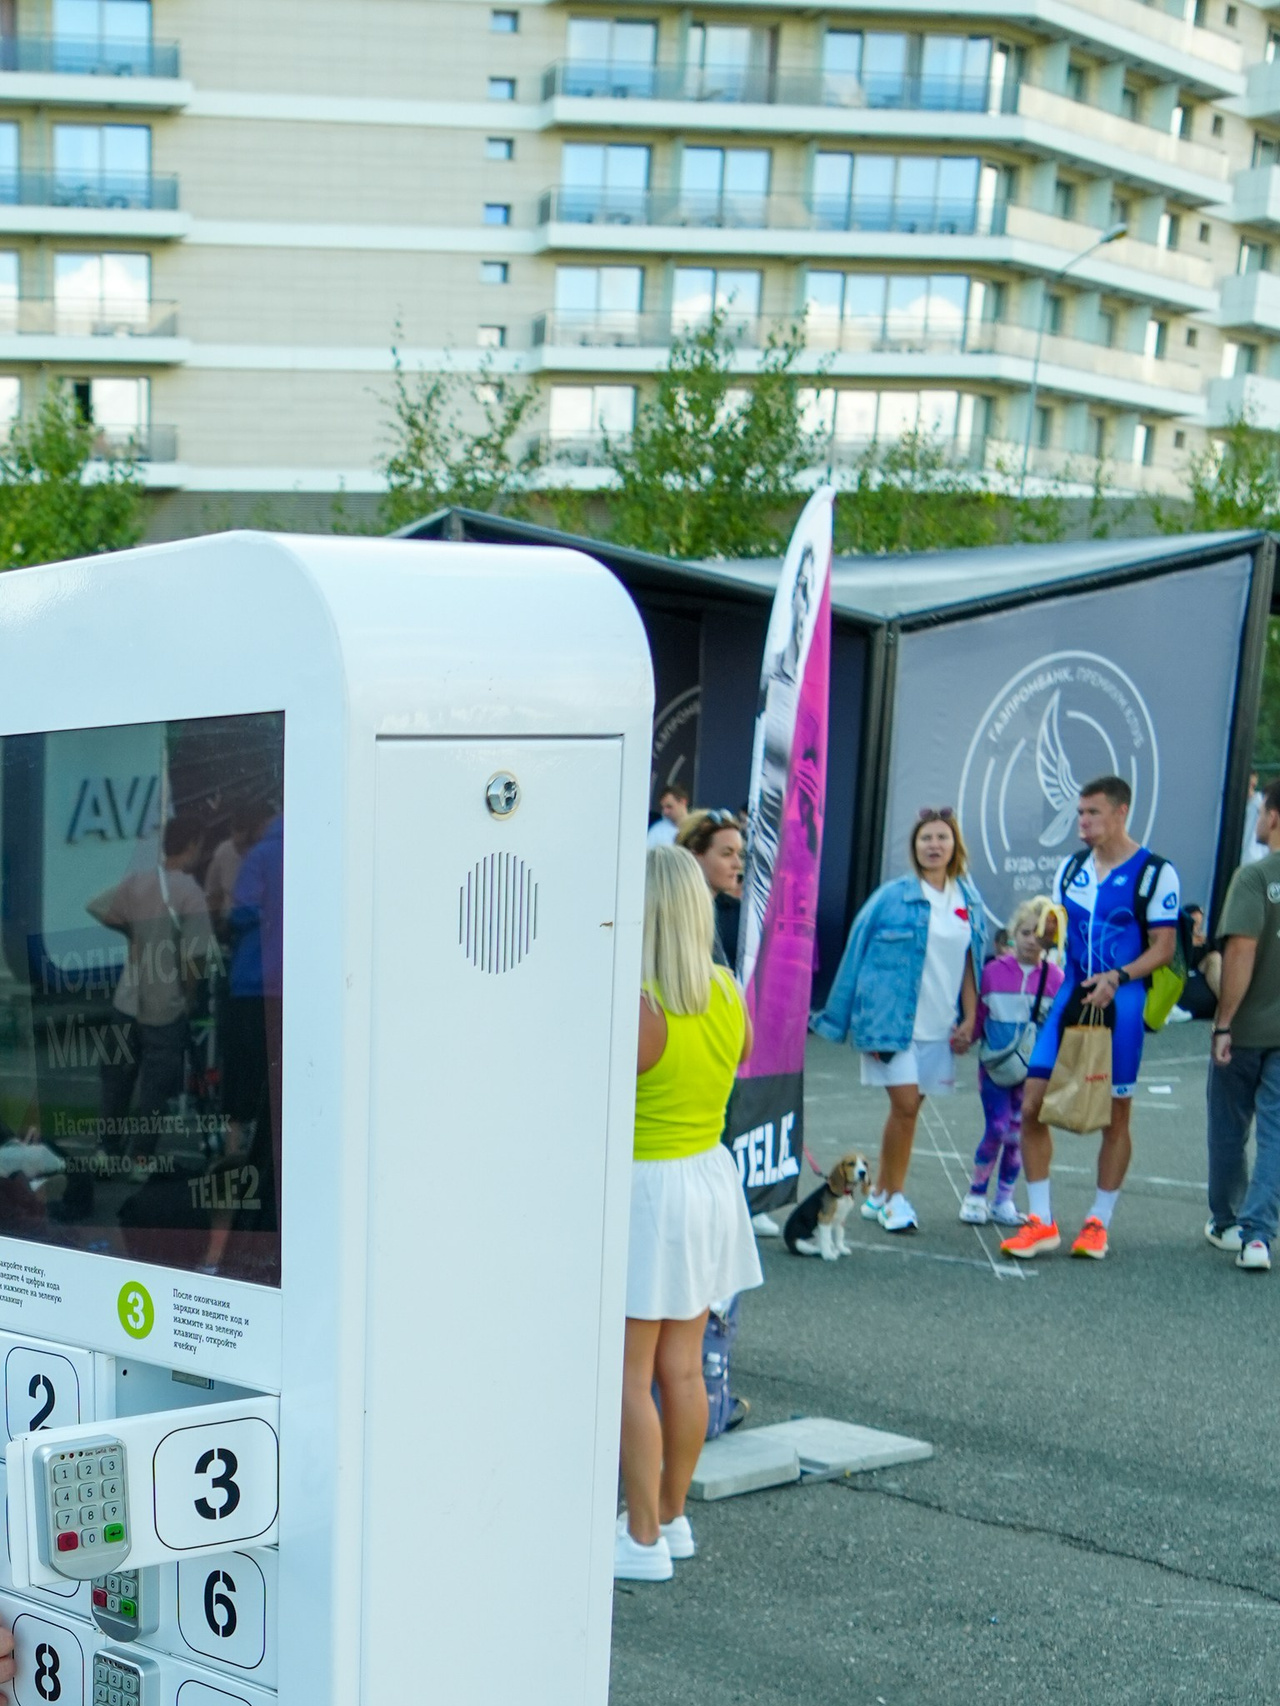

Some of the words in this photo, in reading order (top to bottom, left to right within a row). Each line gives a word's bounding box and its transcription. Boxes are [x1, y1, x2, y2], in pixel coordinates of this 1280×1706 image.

[46, 1013, 136, 1069] Mixx
[196, 1112, 232, 1133] как
[188, 1165, 261, 1210] TELE2
[173, 1288, 192, 1301] После
[194, 1294, 230, 1309] окончания
[127, 1291, 145, 1330] 3
[173, 1303, 200, 1316] зарядки
[202, 1308, 228, 1321] введите
[230, 1315, 242, 1325] код
[244, 1318, 249, 1326] и
[173, 1316, 203, 1329] нажмите
[205, 1322, 213, 1330] на
[215, 1324, 243, 1338] зеленую
[173, 1342, 197, 1355] ячейку
[206, 1336, 237, 1349] откройте
[27, 1373, 55, 1429] 2
[63, 1470, 67, 1479] 1
[86, 1466, 91, 1474] 2
[109, 1461, 115, 1470] 3
[64, 1493, 69, 1501] 4
[87, 1488, 93, 1497] 5
[111, 1485, 116, 1493] 6
[193, 1448, 241, 1520] 3
[65, 1515, 69, 1524] 7
[88, 1511, 94, 1520] 8
[112, 1507, 116, 1515] 9
[89, 1534, 95, 1543] 0
[111, 1580, 114, 1588] 8
[111, 1600, 115, 1608] 0
[203, 1569, 238, 1638] 6
[34, 1643, 62, 1703] 8
